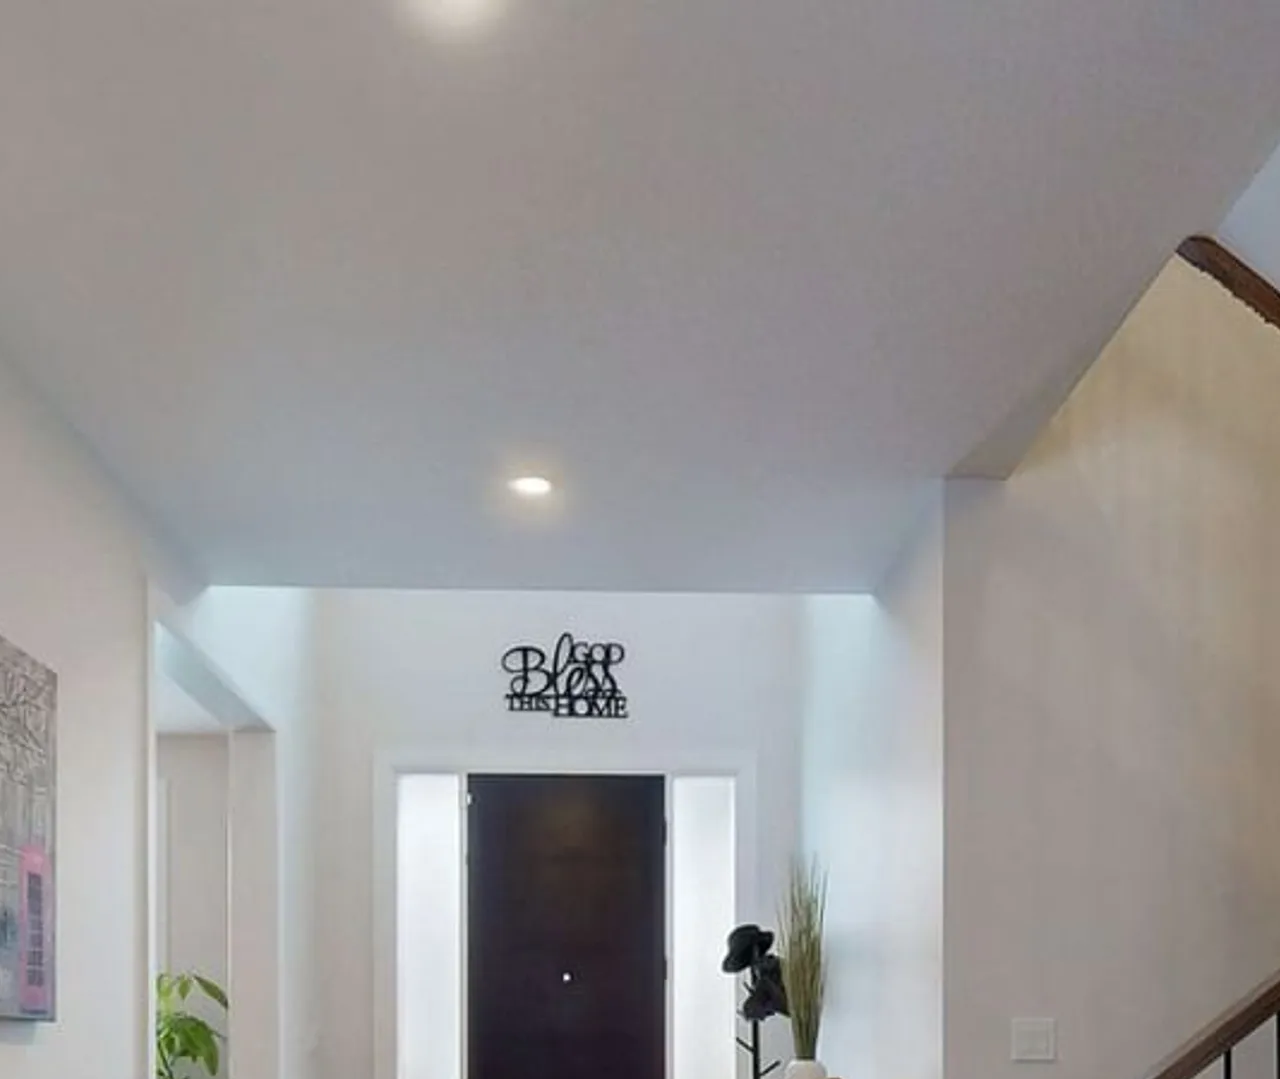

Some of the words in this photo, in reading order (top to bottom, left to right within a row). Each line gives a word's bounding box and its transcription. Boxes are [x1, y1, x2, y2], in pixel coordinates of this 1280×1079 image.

[501, 632, 622, 698] Bless
[572, 641, 625, 665] GOD
[505, 694, 552, 711] THIS
[553, 695, 628, 718] HOME
